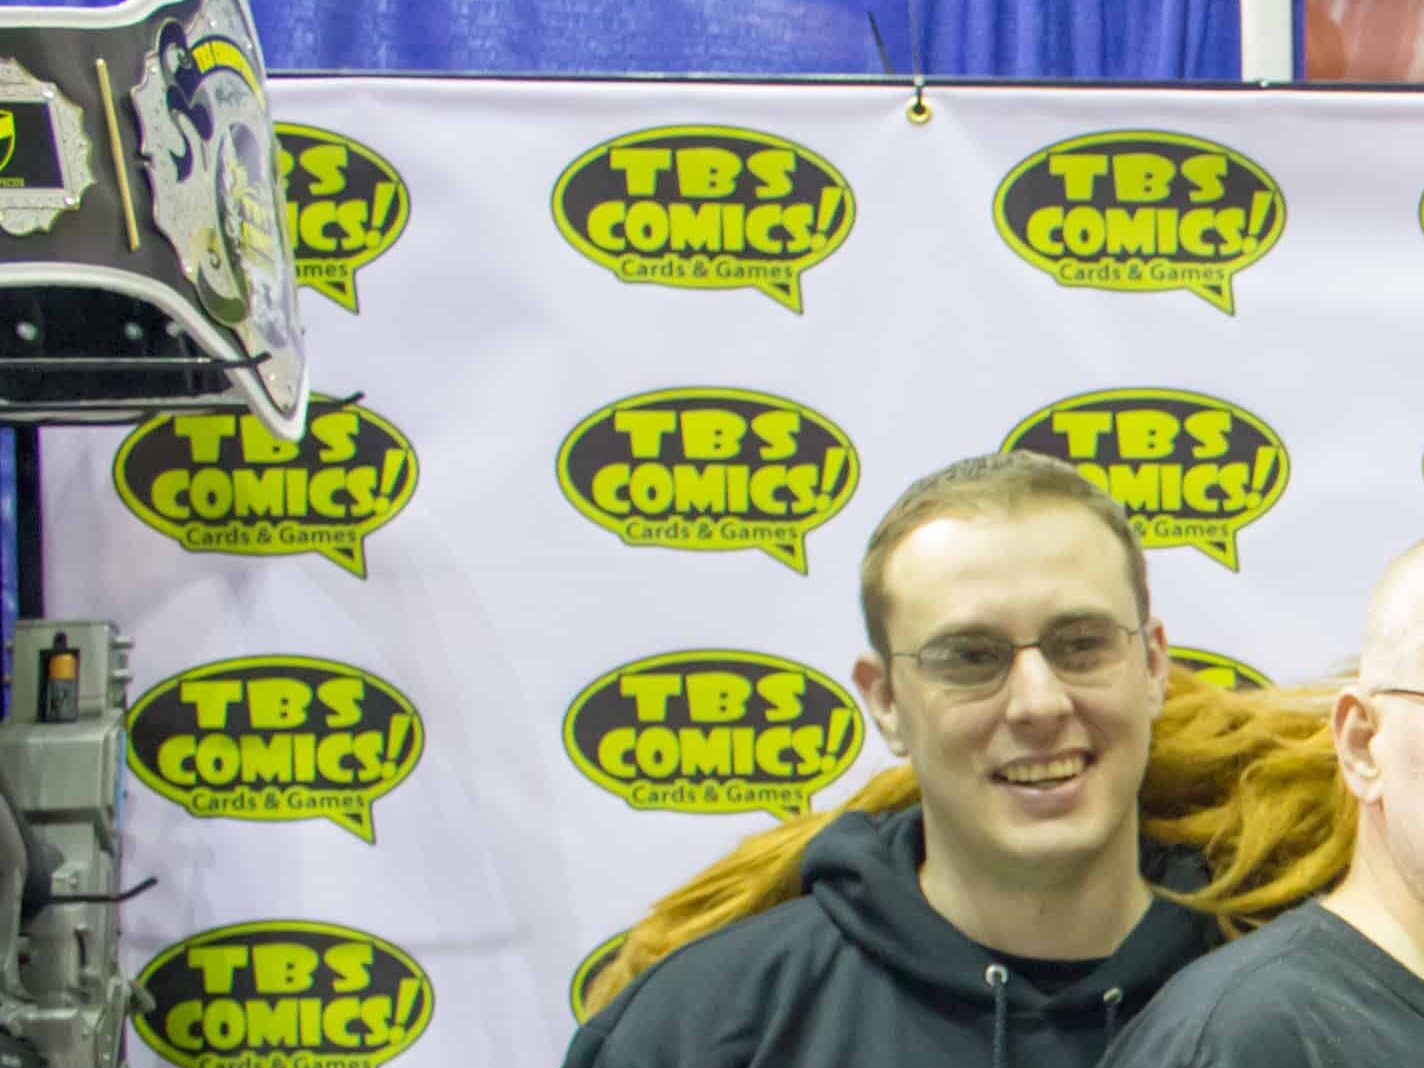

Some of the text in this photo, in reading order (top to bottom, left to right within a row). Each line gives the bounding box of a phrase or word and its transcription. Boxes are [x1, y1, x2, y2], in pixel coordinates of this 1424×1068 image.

[609, 147, 796, 199] TBS
[1047, 152, 1229, 203] TBS
[587, 186, 843, 253] COMICS!
[1026, 189, 1274, 257] COMICS!
[620, 258, 793, 280] Cards & Games
[1058, 262, 1226, 283] Cards & Games
[613, 408, 801, 460] TBS
[1051, 409, 1232, 460] TBS
[150, 448, 407, 520] COMICS!
[591, 446, 847, 515] COMICS!
[183, 525, 357, 547] Cards & Games
[625, 520, 798, 541] Cards & Games
[1154, 519, 1230, 539] Games
[179, 676, 366, 730] TBS
[619, 670, 806, 723] TBS
[158, 713, 413, 786] COMICS!
[598, 707, 852, 779] COMICS!
[192, 790, 364, 813] Cards & Games
[631, 783, 803, 805] Cards & Games
[186, 941, 374, 994] TBS
[164, 977, 421, 1051] COMICS!
